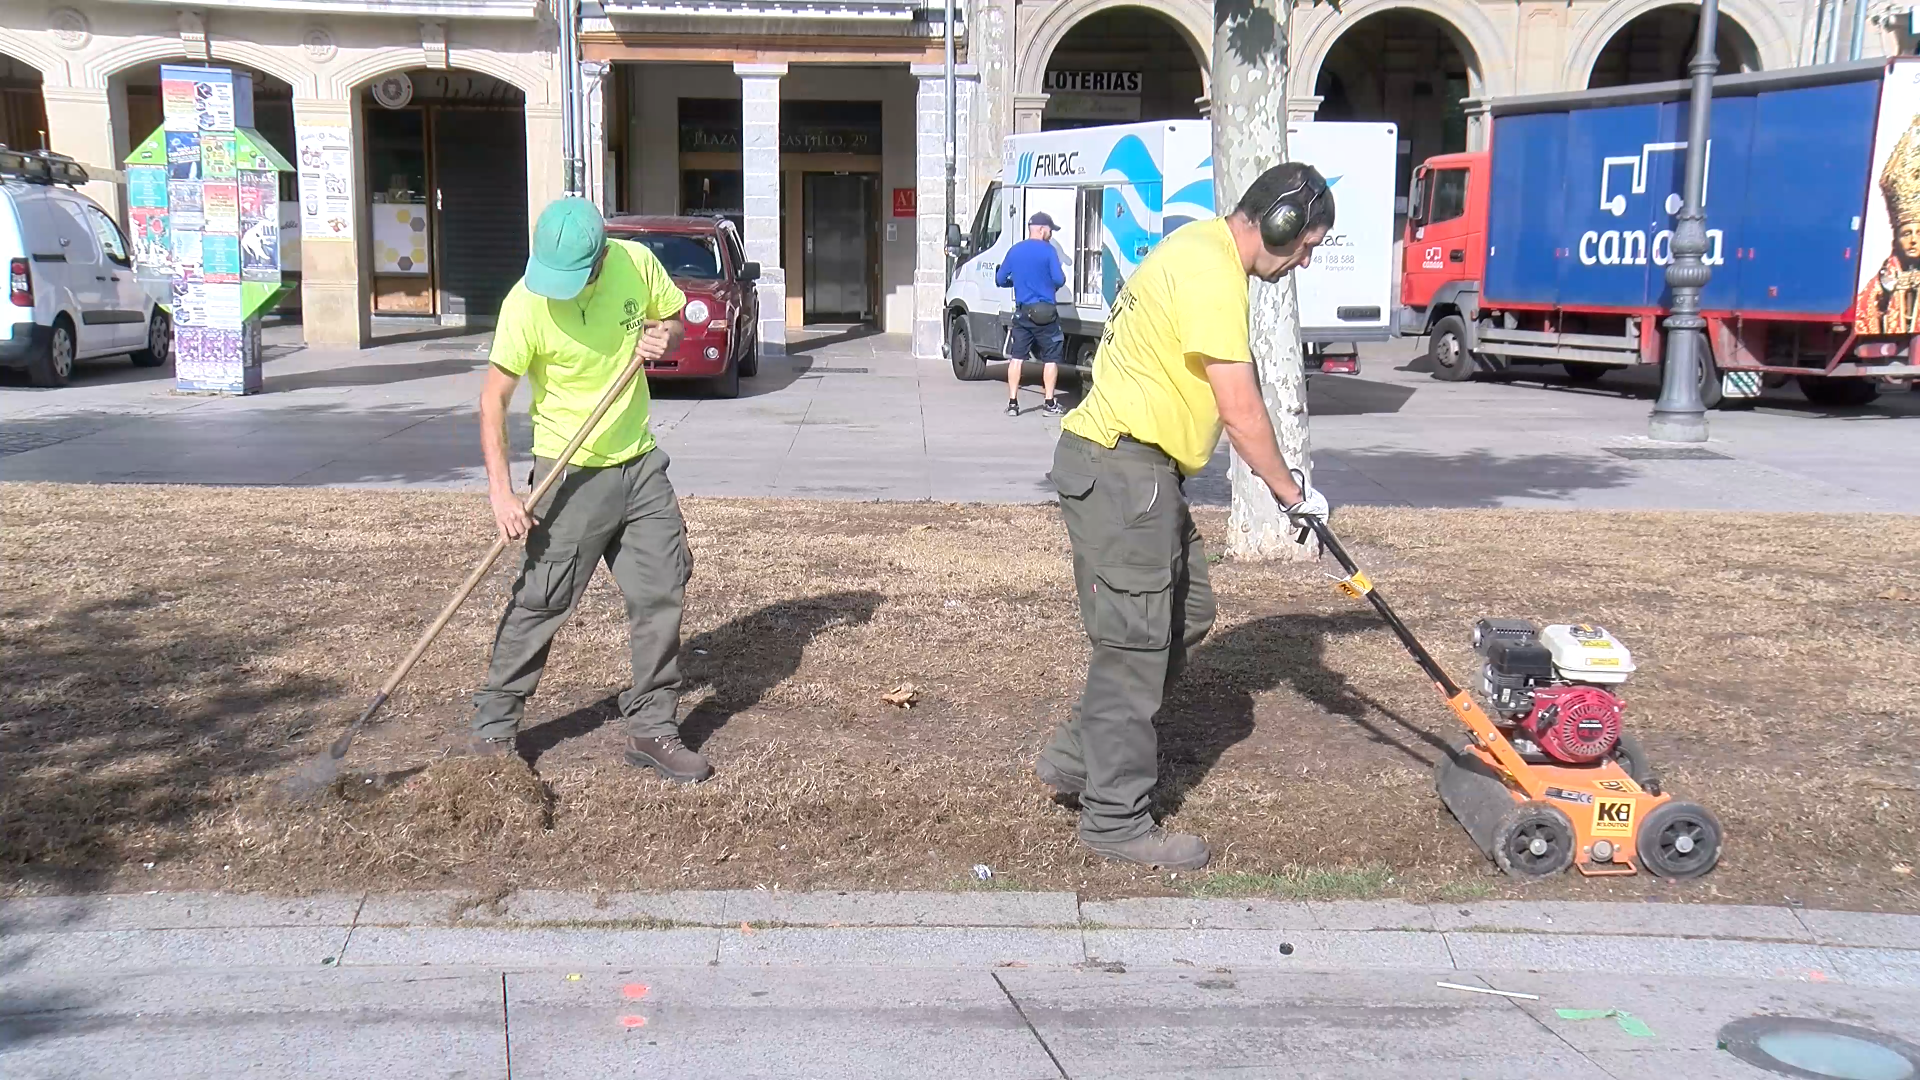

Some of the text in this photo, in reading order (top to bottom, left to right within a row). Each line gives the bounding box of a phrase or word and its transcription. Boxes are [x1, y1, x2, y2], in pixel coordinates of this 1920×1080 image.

[1045, 72, 1138, 91] LOTERIAS
[694, 131, 737, 146] PLAZA
[853, 134, 868, 147] 29
[1579, 229, 1724, 265] canaa
[1313, 255, 1355, 264] 48 188 588
